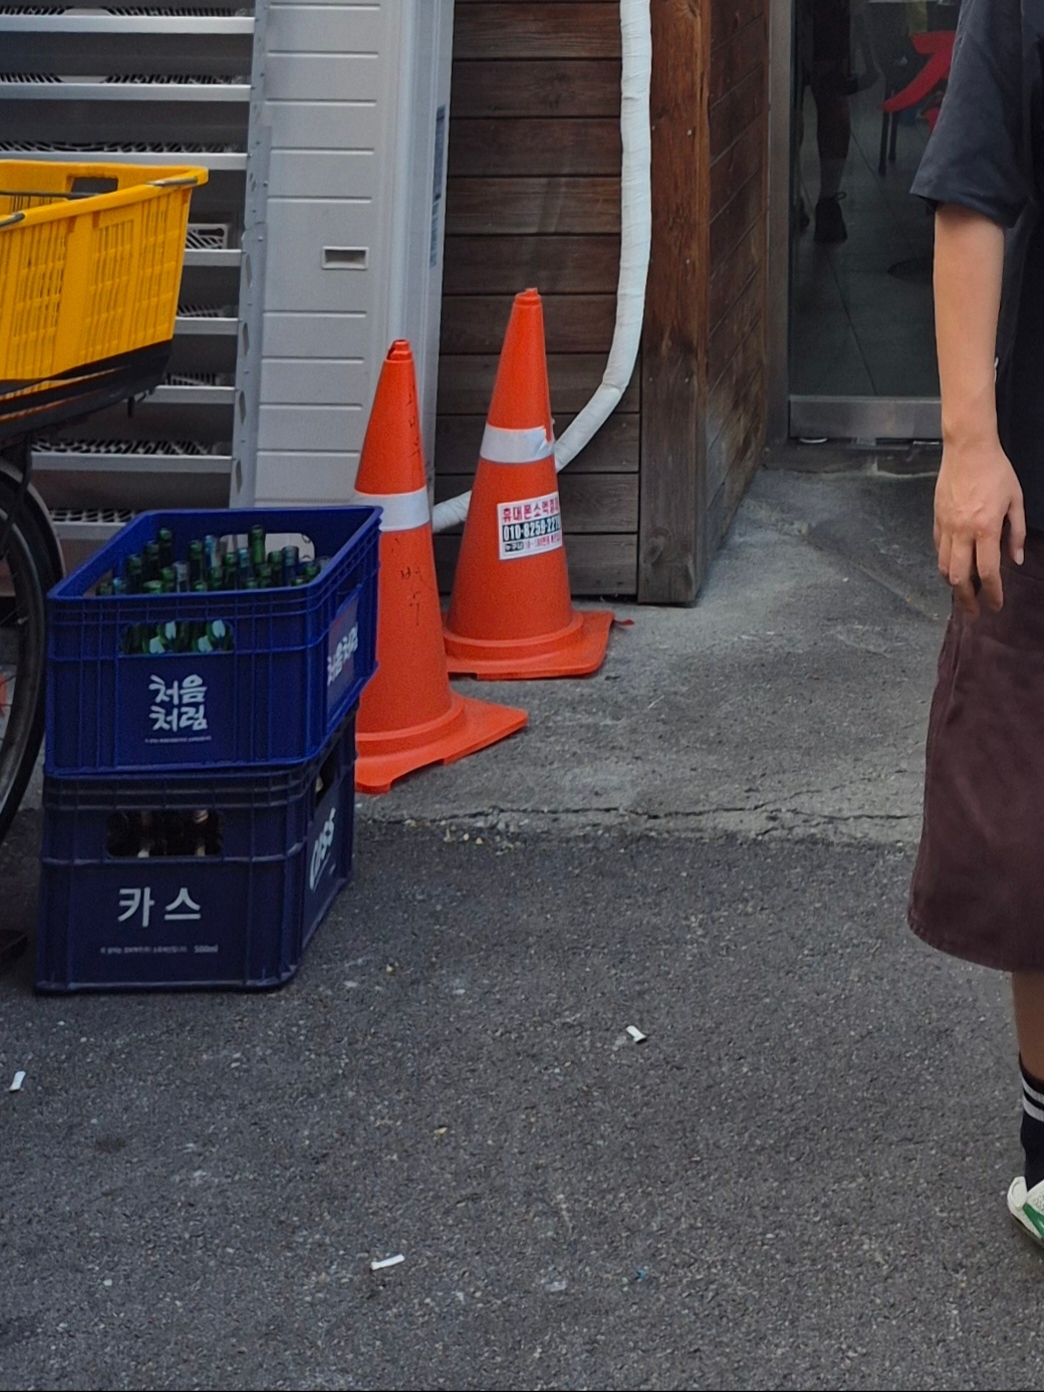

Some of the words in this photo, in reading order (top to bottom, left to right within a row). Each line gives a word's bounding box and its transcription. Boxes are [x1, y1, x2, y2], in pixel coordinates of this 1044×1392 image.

[148, 674, 208, 706] 처음
[148, 704, 209, 733] 처럼
[117, 886, 201, 928] 카스
